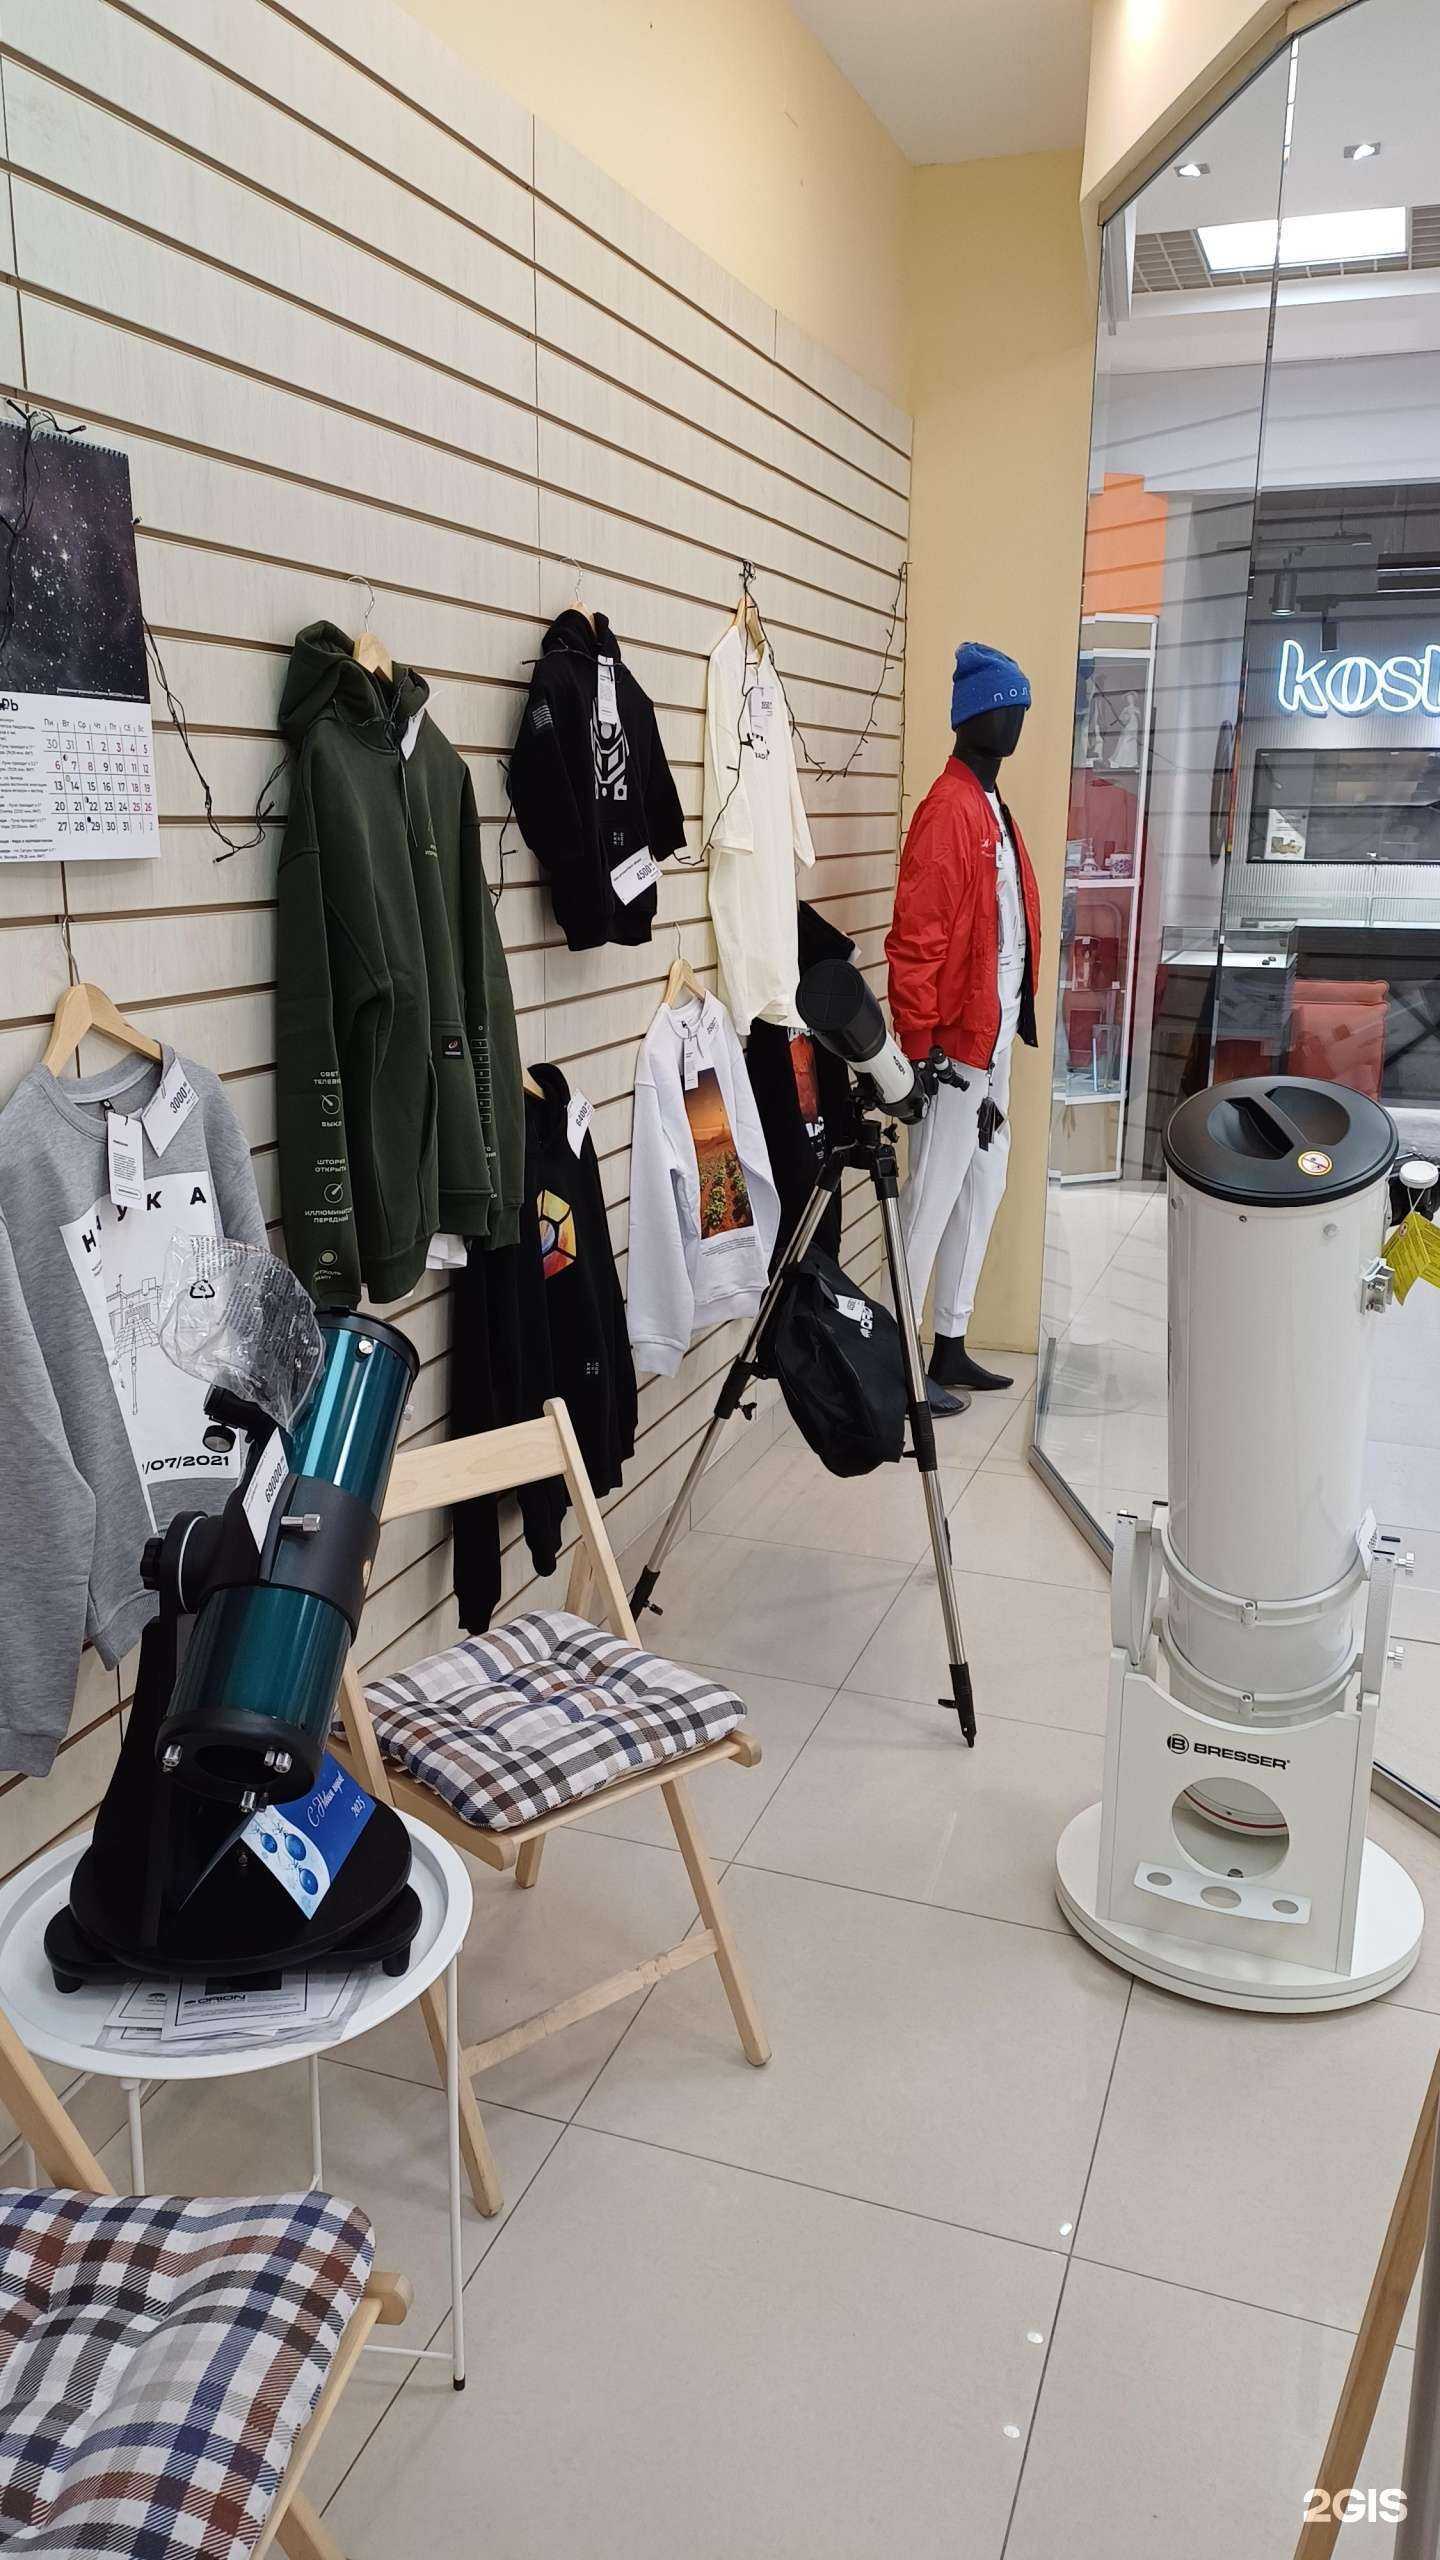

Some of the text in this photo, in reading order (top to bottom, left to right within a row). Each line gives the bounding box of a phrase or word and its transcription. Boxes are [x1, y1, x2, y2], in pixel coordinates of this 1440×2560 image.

[100, 741, 107, 752] 2
[54, 760, 61, 770] 6
[103, 762, 109, 772] 9
[115, 762, 124, 772] 10
[131, 763, 137, 773] 11
[142, 763, 149, 774] 12
[54, 780, 63, 791] 13
[70, 781, 79, 791] 14
[87, 781, 96, 792] 15
[102, 782, 112, 792] 16
[118, 782, 125, 792] 17
[131, 783, 139, 793] 18
[55, 801, 65, 811] 20
[73, 802, 82, 811] 21
[89, 802, 98, 811] 22
[104, 802, 113, 812] 23
[118, 802, 128, 812] 24
[132, 802, 141, 812] 25
[57, 821, 67, 831] 27
[74, 821, 85, 832] 28
[91, 821, 101, 831] 29
[106, 821, 116, 831] 30
[122, 821, 130, 831] 31
[170, 1087, 188, 1114] 3000
[265, 1462, 282, 1503] 69000
[1194, 1743, 1287, 1770] BRESSER
